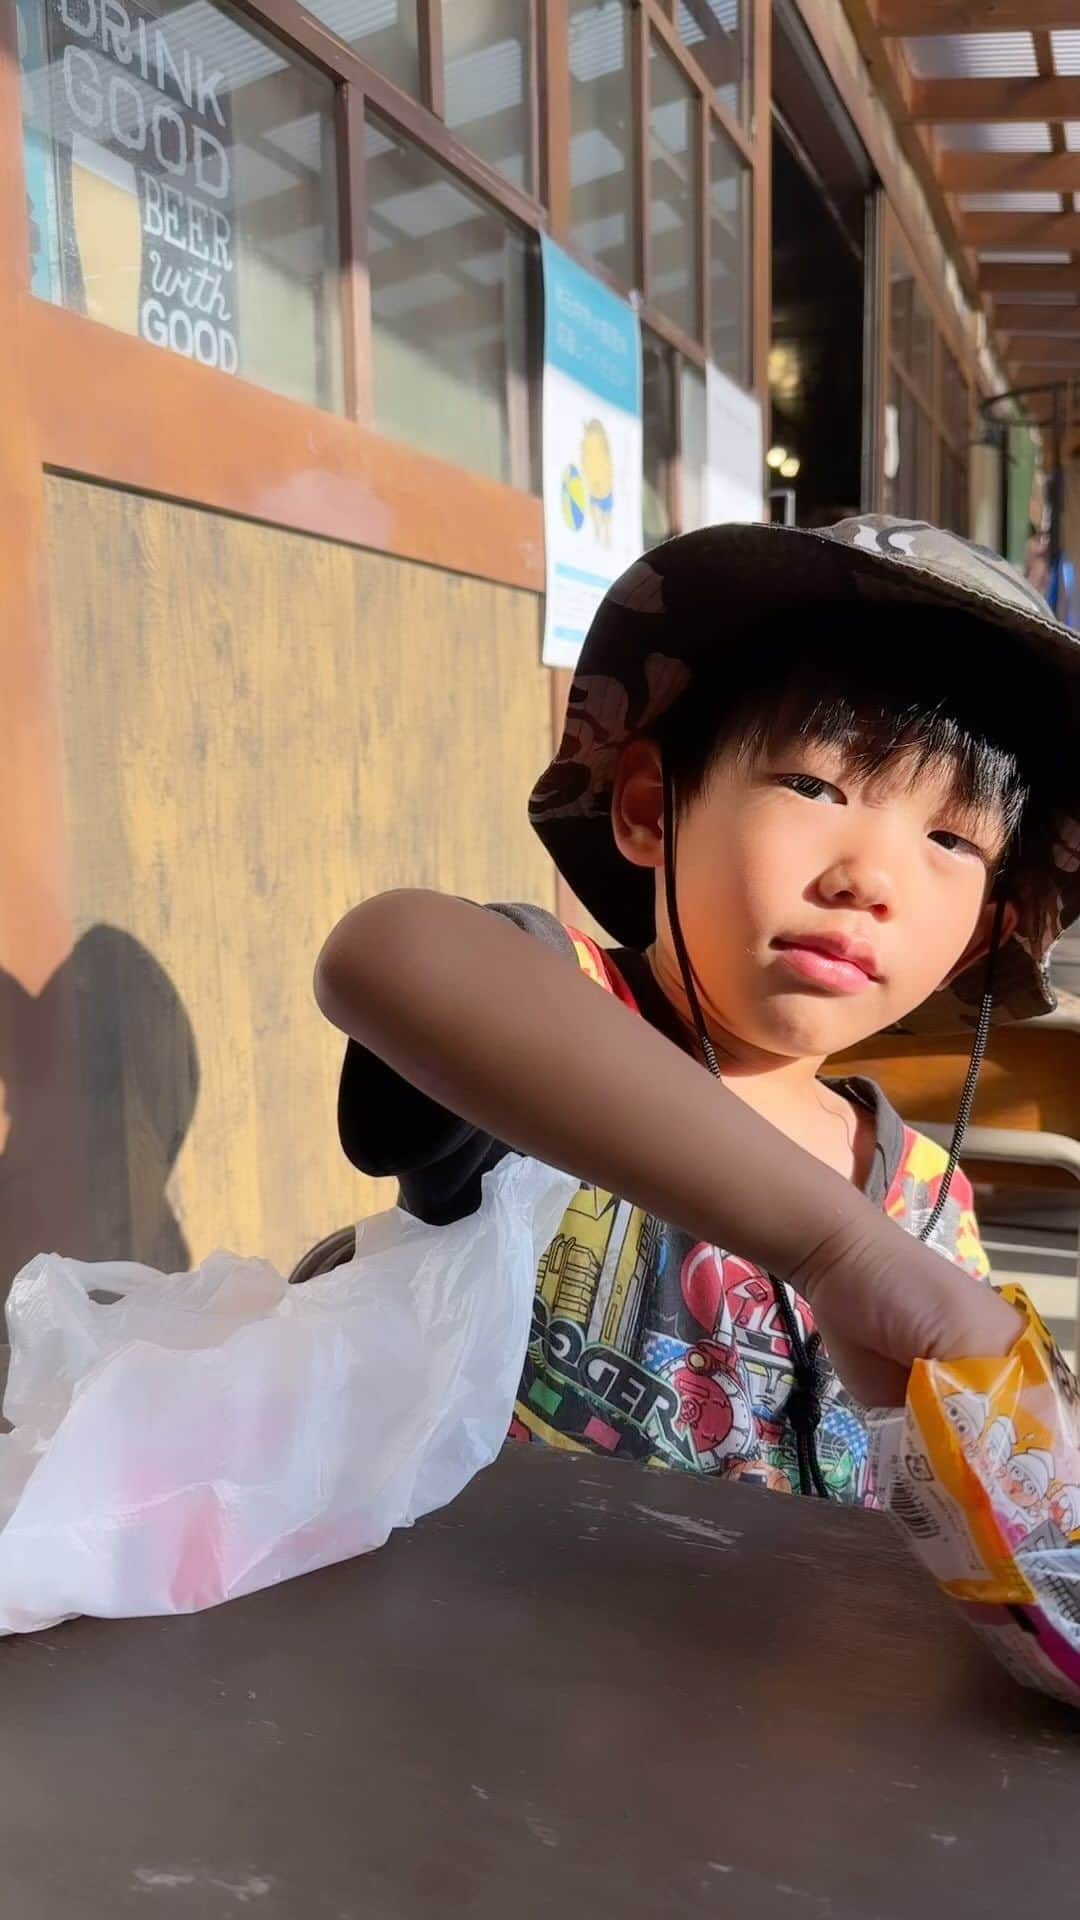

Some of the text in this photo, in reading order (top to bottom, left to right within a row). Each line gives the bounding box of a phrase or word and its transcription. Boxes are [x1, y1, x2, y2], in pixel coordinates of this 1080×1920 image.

[63, 44, 231, 199] GOOD
[141, 172, 233, 272] BEER
[149, 251, 232, 322] with
[141, 298, 239, 376] GOOD
